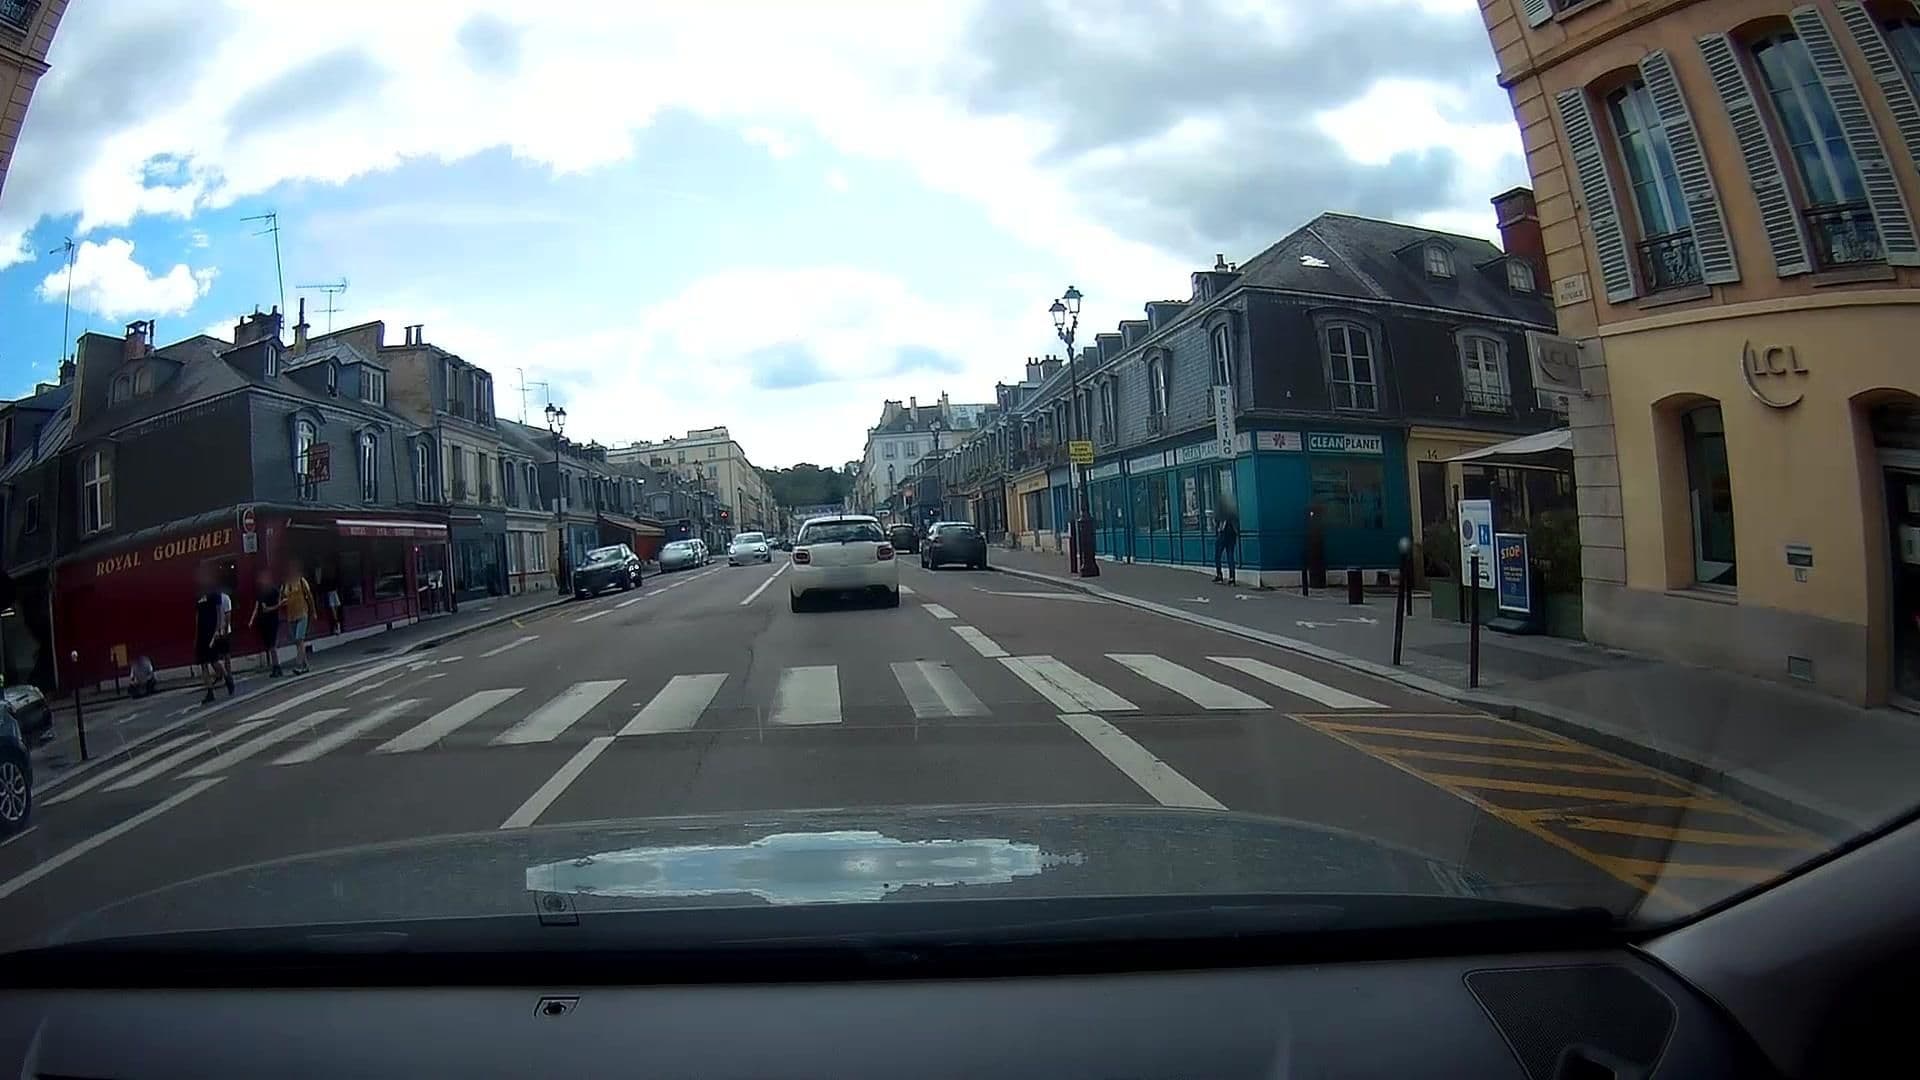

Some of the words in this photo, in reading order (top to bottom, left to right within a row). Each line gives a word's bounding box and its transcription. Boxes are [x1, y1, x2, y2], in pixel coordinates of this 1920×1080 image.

[1752, 344, 1809, 376] LCL
[1219, 389, 1232, 455] PRESSING
[1310, 436, 1344, 449] CLEAN
[1345, 438, 1381, 450] PLANET
[96, 551, 142, 577] ROYAL
[153, 528, 232, 561] GOURMET
